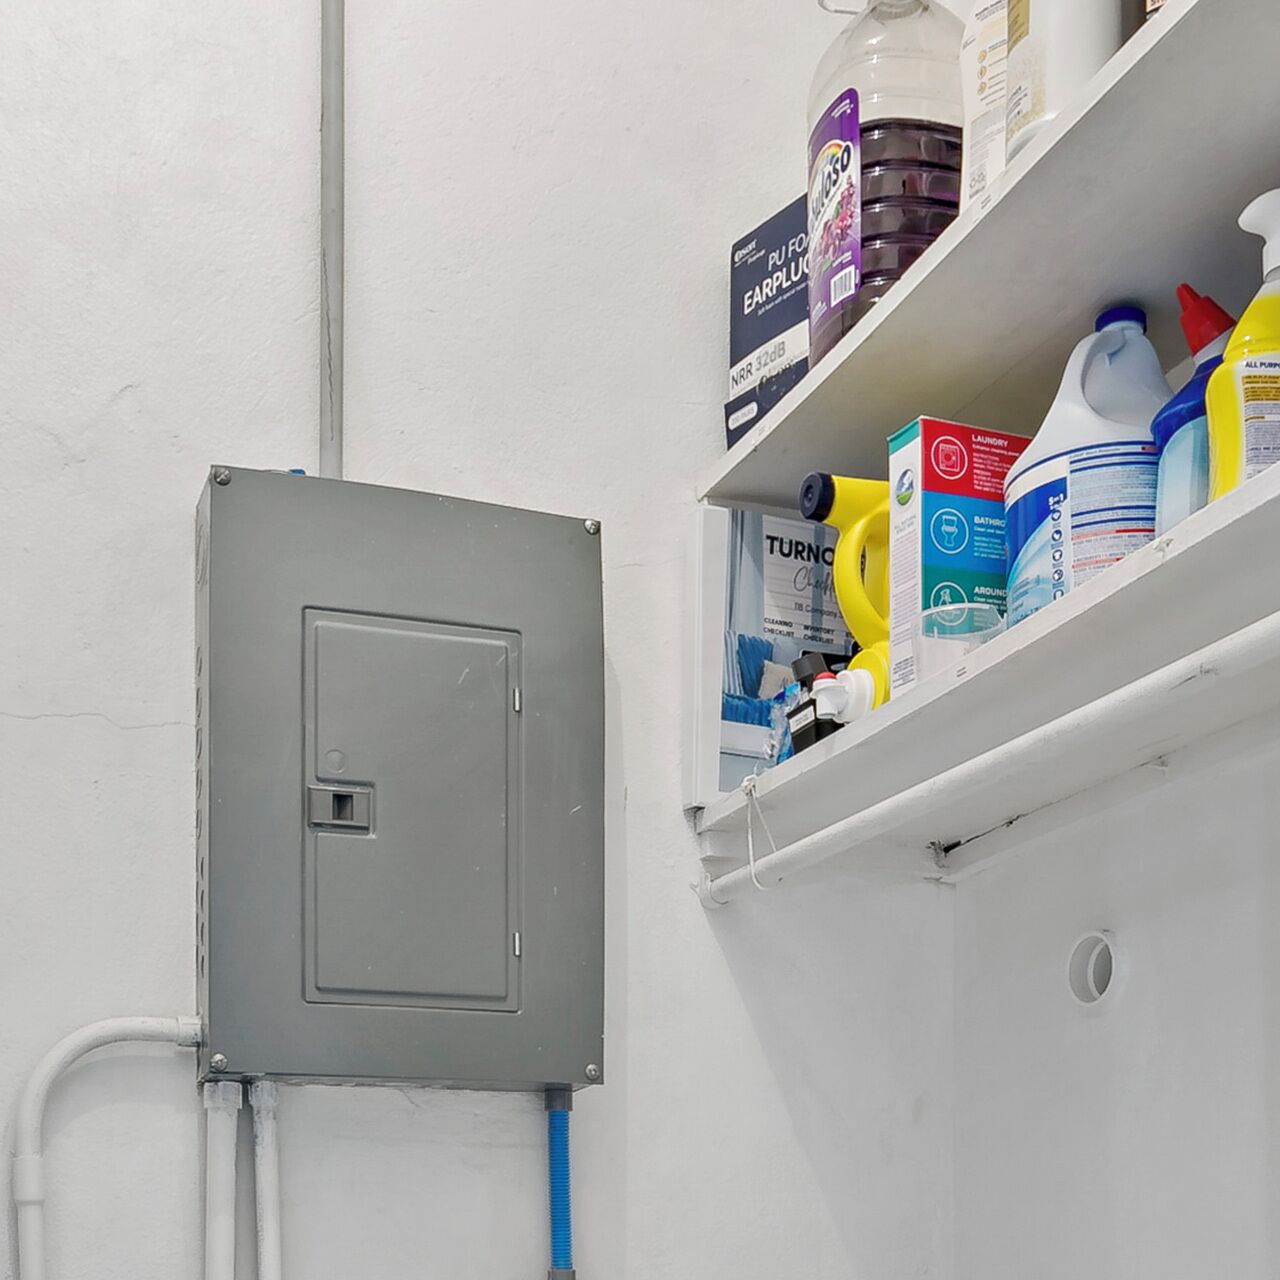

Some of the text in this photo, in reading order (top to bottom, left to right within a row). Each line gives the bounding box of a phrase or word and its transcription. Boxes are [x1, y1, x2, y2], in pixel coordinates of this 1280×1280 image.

[768, 245, 786, 271] PU
[731, 341, 786, 389] NRR 32dB
[1245, 361, 1258, 369] ALL
[972, 434, 1009, 447] LAUNDRY
[805, 605, 837, 618] Company
